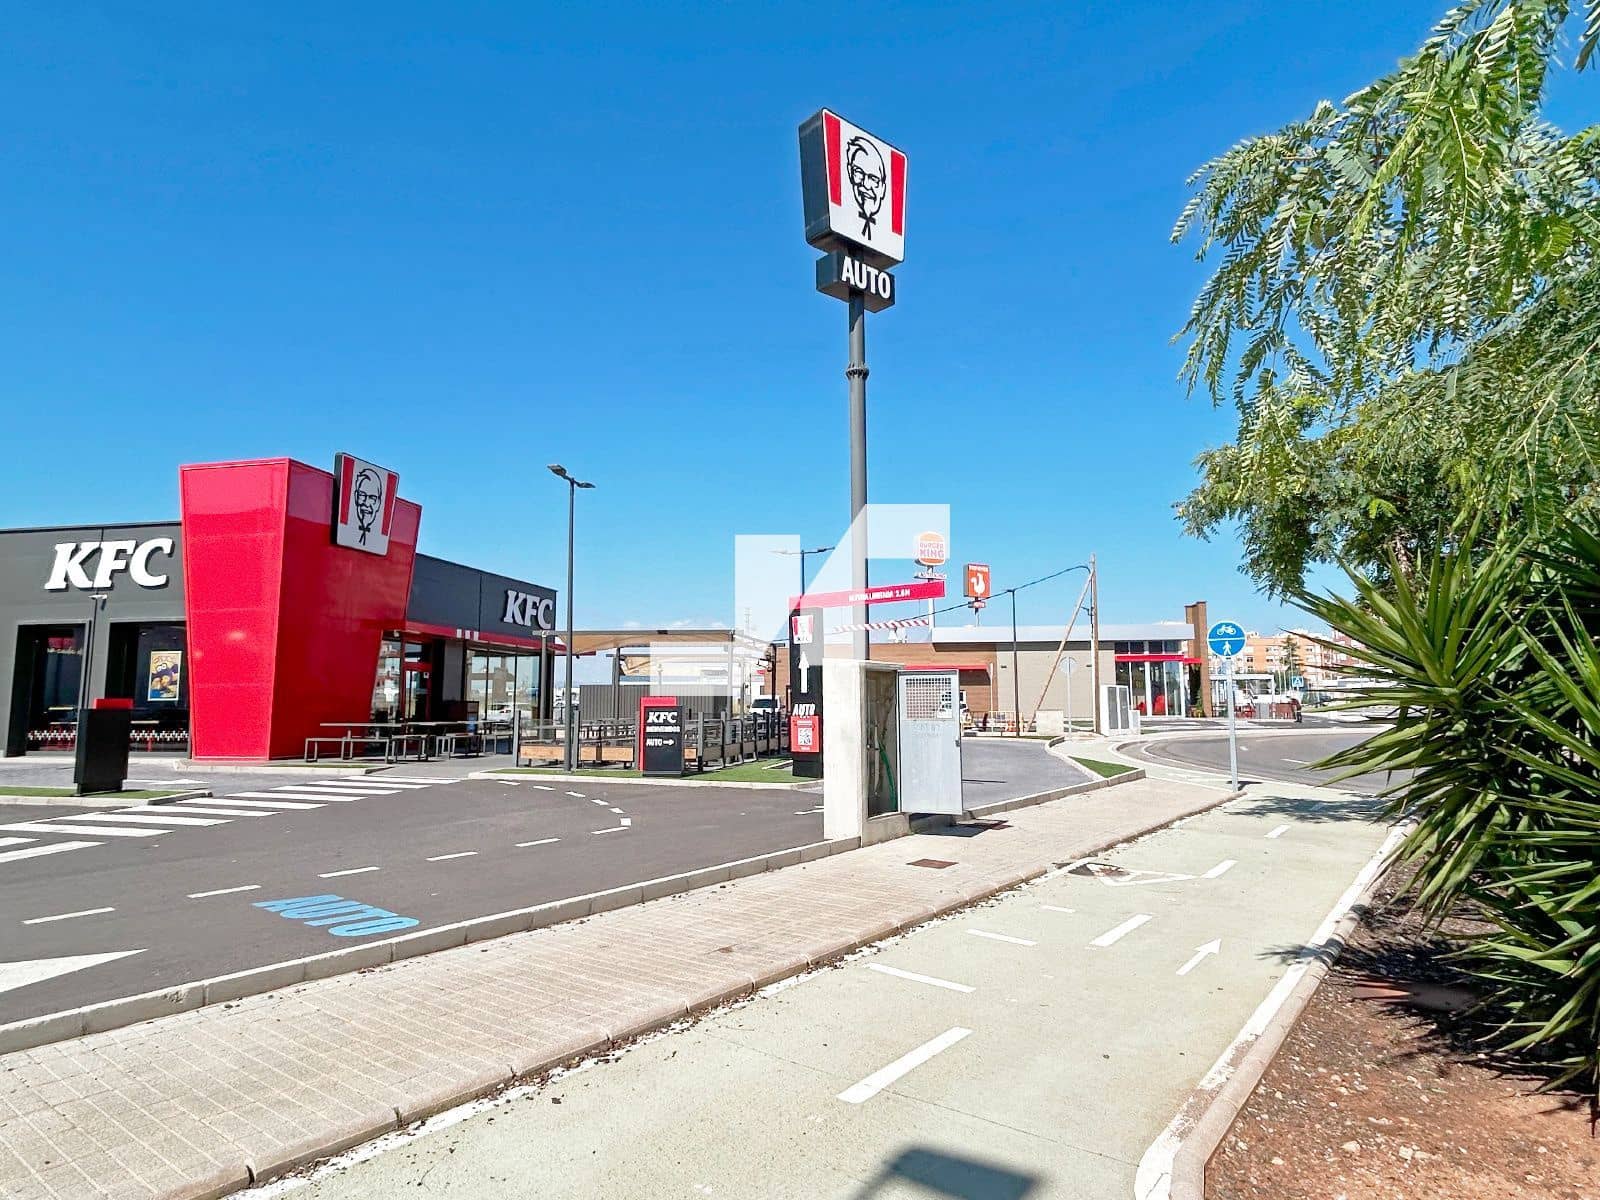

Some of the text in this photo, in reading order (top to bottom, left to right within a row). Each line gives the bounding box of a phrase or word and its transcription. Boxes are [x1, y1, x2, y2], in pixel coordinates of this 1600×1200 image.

[841, 255, 891, 299] AUTO
[44, 537, 173, 590] KFC
[920, 548, 944, 558] KING
[503, 590, 553, 630] KFC
[646, 711, 678, 724] KFC
[792, 703, 816, 718] AUTO
[646, 738, 663, 747] AUTO
[252, 894, 419, 937] AUTO
